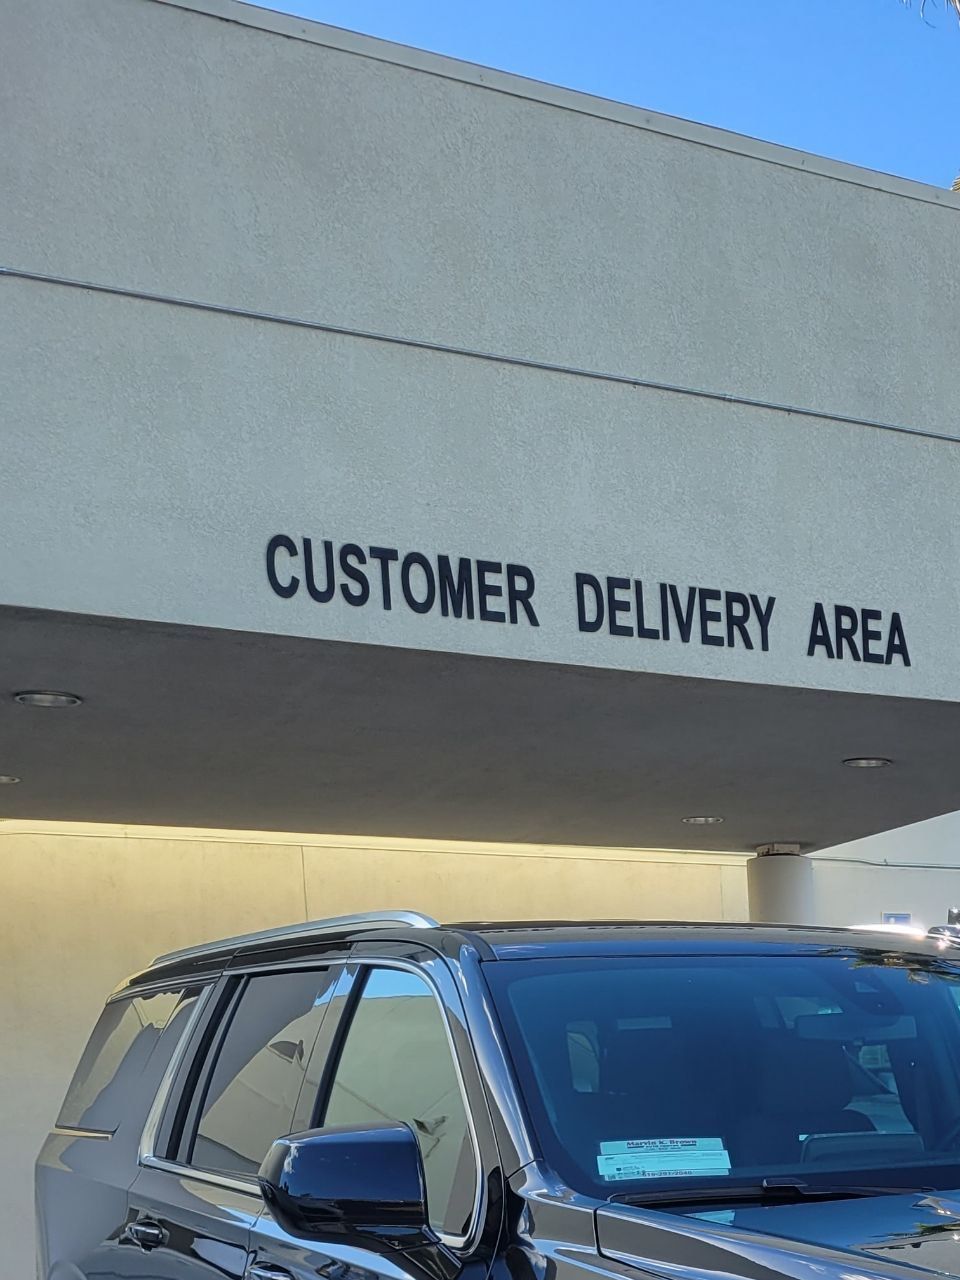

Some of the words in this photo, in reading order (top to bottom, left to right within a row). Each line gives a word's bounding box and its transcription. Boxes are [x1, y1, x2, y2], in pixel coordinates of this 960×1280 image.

[266, 533, 540, 627] CUSTOMER
[574, 571, 776, 652] DELIVERY
[806, 602, 912, 667] AREA
